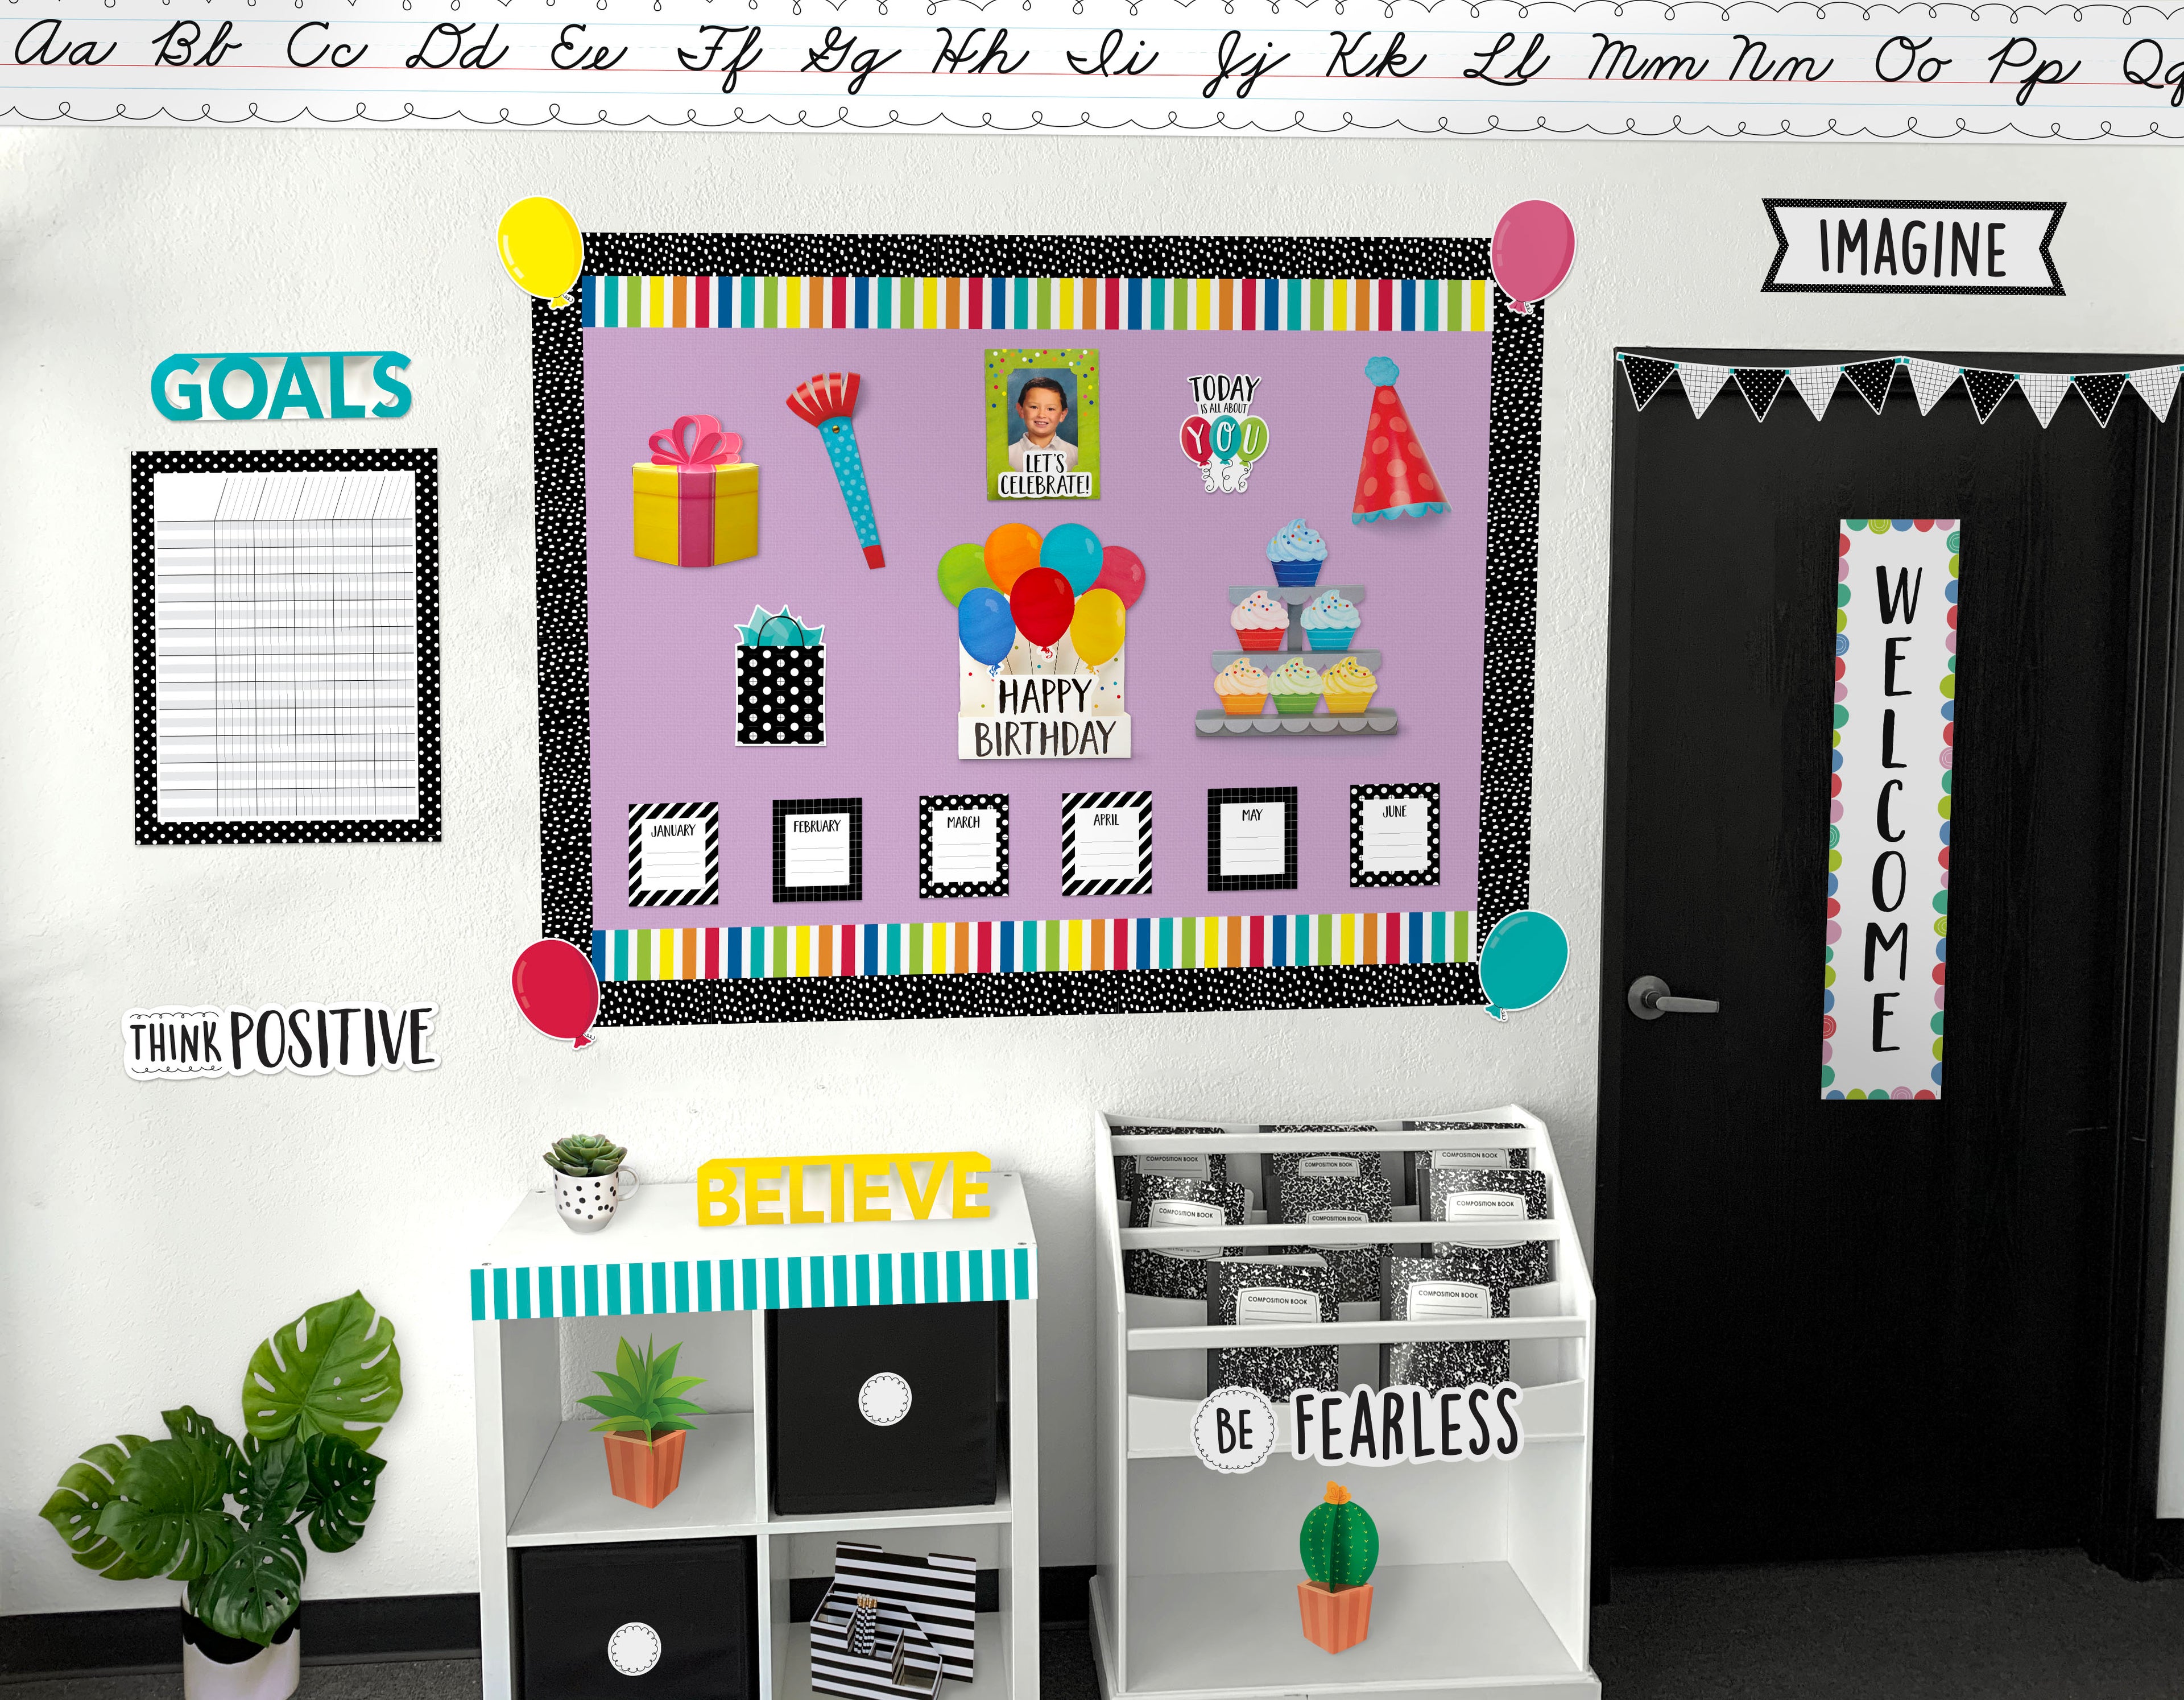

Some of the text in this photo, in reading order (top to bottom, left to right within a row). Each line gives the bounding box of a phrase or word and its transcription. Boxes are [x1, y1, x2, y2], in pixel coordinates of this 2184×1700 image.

[14, 19, 118, 66] Aa
[152, 20, 242, 67] Bb
[287, 21, 369, 68] Cc
[406, 22, 510, 69] Dd
[551, 23, 628, 71] Ee
[677, 24, 763, 94] Ff
[800, 26, 902, 96] Gg
[932, 27, 1030, 75] Hh
[1066, 28, 1159, 77] Ii
[1202, 30, 1291, 99] Jj
[1326, 31, 1428, 78] Kk
[1463, 32, 1550, 86] Ll
[1588, 32, 1710, 81] Mm
[1728, 34, 1834, 82] Nn
[1875, 35, 1953, 83] Oo
[1988, 37, 2086, 106] Pp
[1820, 217, 2007, 278] IMAGINE
[151, 351, 412, 421] GOALS
[1189, 375, 1260, 402] TODAY
[1201, 403, 1248, 414] IS ALL ABOUT
[1187, 422, 1261, 454] YOU
[1026, 453, 1064, 473] LET'S
[1000, 475, 1089, 495] CELEBRATE!
[999, 678, 1093, 715] HAPPY
[975, 720, 1116, 757] BIRTHDAY
[1242, 809, 1263, 821] MAY
[1383, 805, 1407, 818] JUNE
[1864, 565, 1923, 1052] WELCOME
[793, 820, 841, 833] FEBRUARY
[947, 816, 980, 829] MARCH
[1093, 813, 1120, 826] APRIL
[651, 824, 696, 838] JANUARY
[130, 1007, 435, 1070] THINK POSITIVE
[697, 1151, 991, 1227] BELIEVE
[1159, 1207, 1196, 1217] COMPOSITION
[1247, 1296, 1289, 1304] COMPOSITION
[1418, 1289, 1460, 1298] COMPOSITION
[1216, 1387, 1519, 1461] BE FEARLESS
